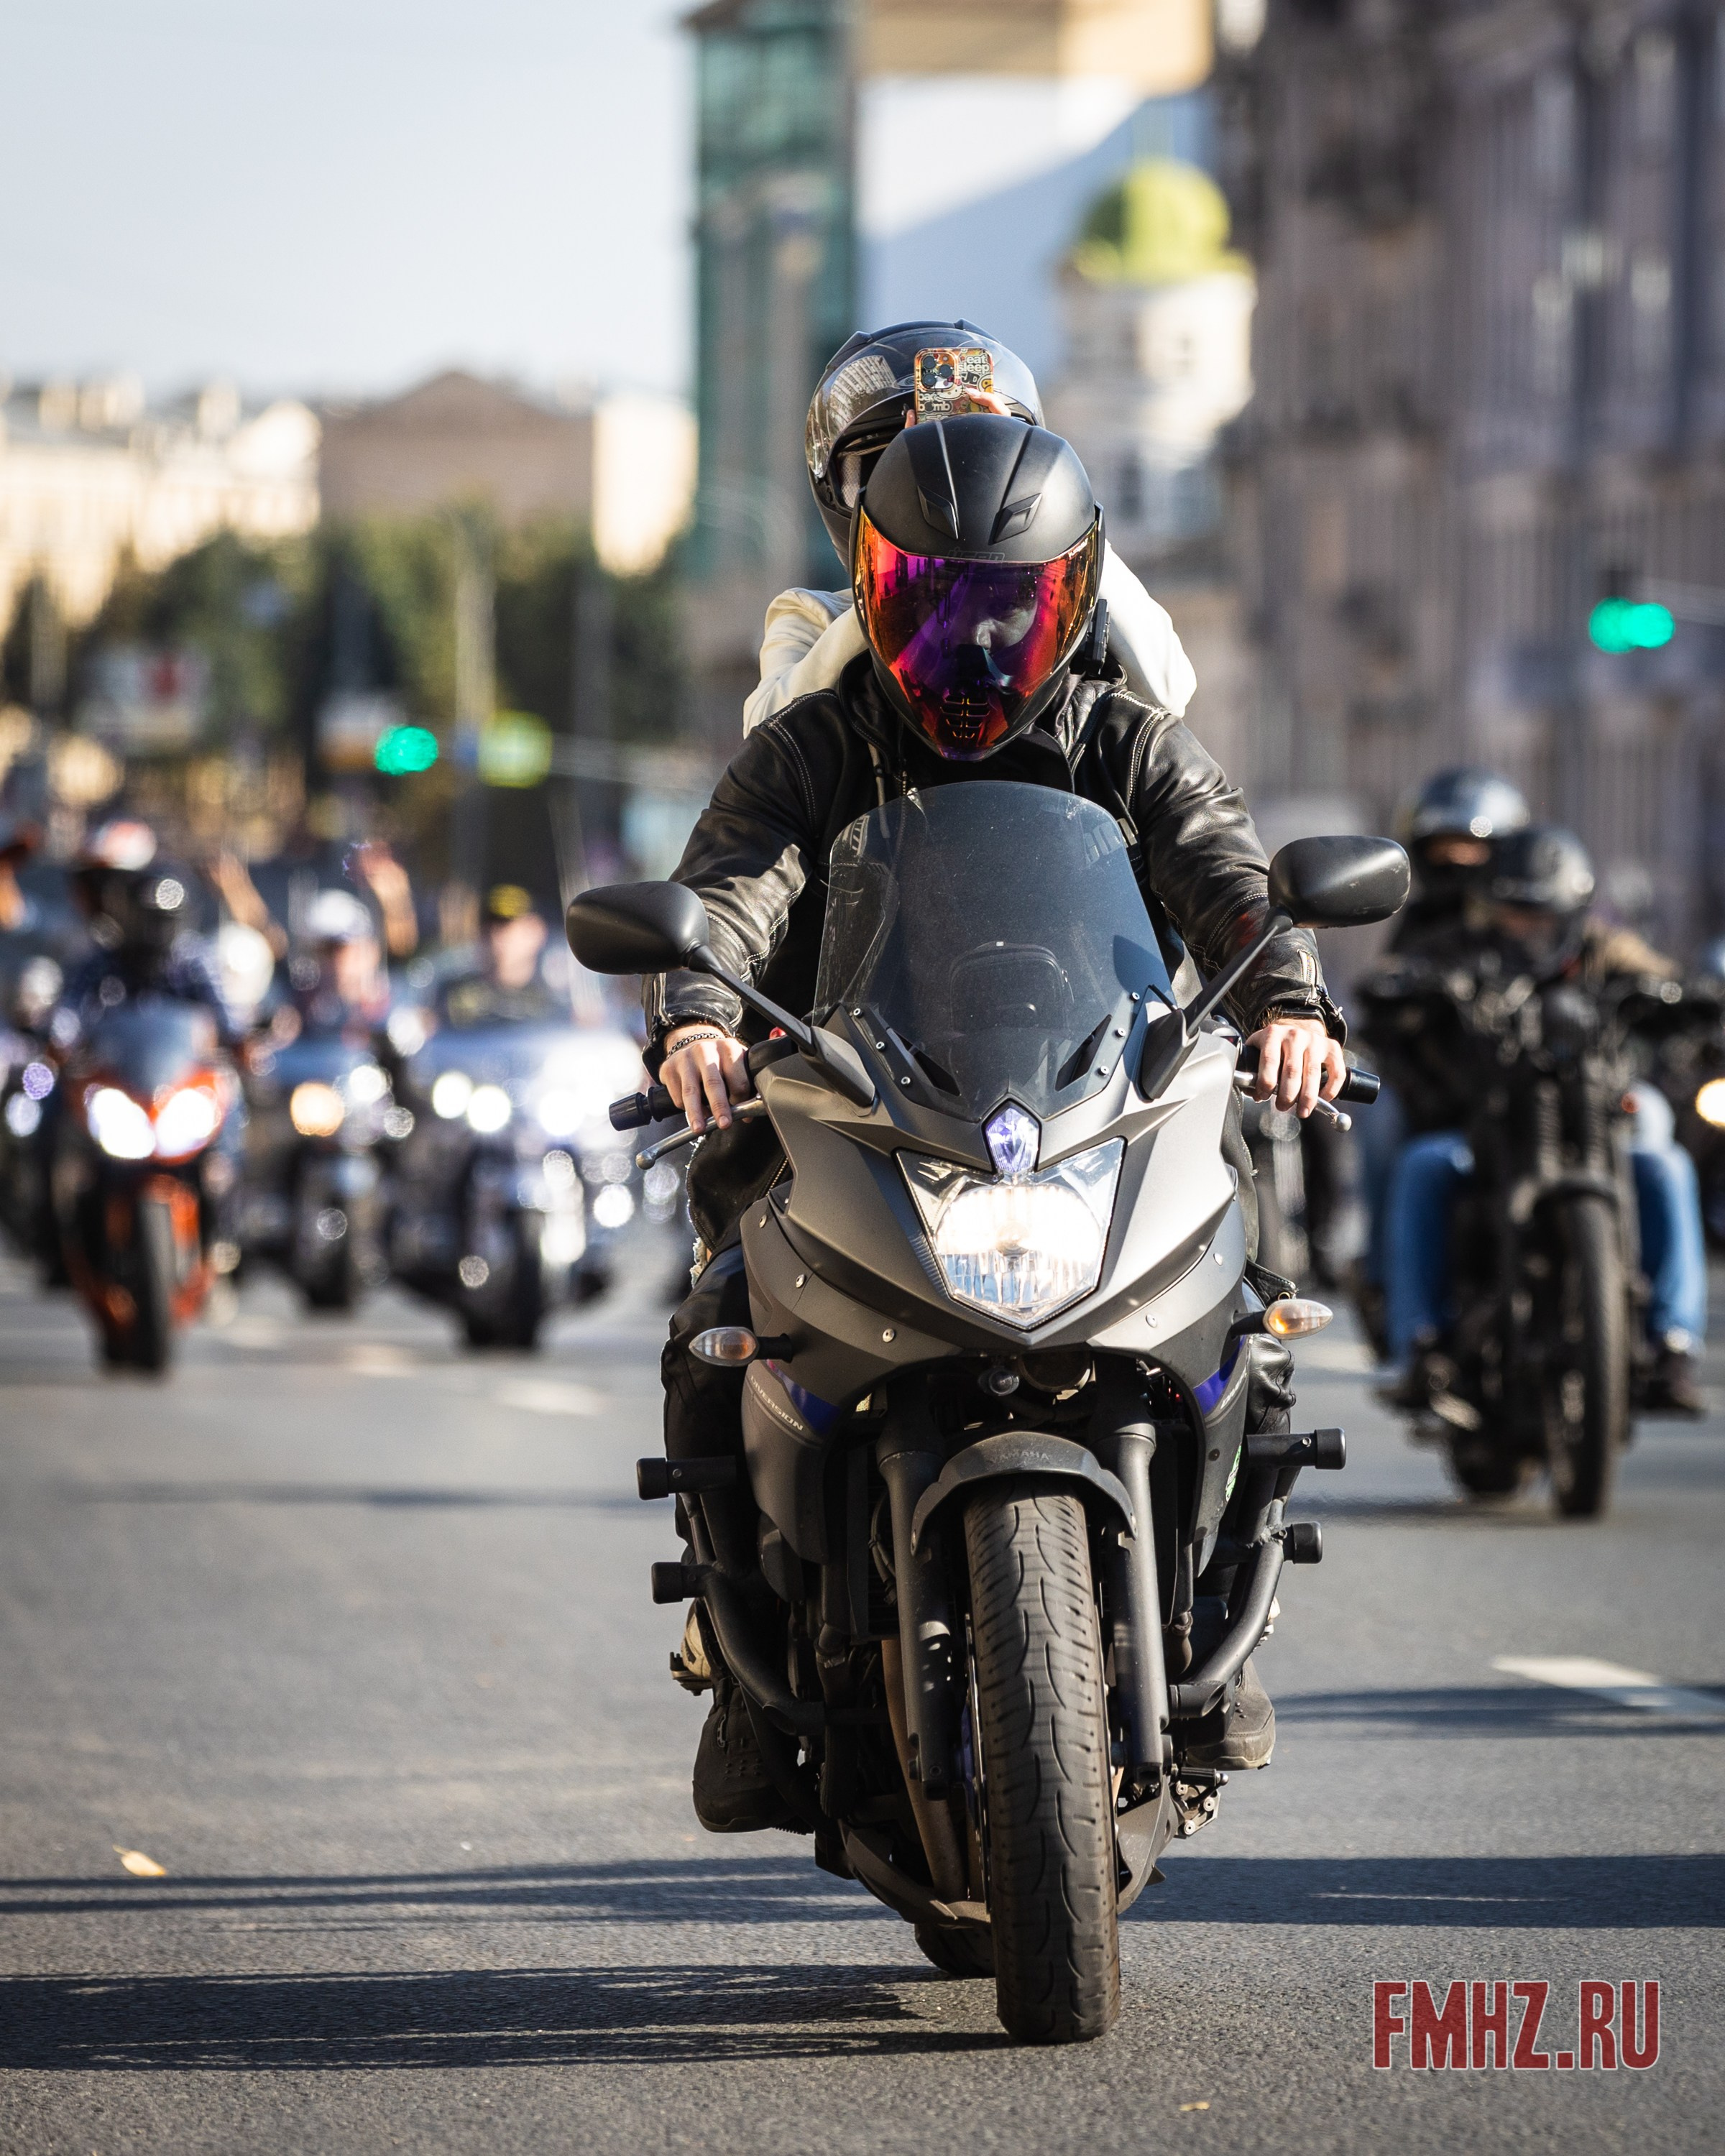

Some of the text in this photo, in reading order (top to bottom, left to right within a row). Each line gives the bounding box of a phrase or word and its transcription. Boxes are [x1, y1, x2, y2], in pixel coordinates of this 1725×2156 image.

[966, 355, 985, 364] eat
[959, 362, 990, 374] sleep
[750, 1376, 804, 1431] DIVERSION
